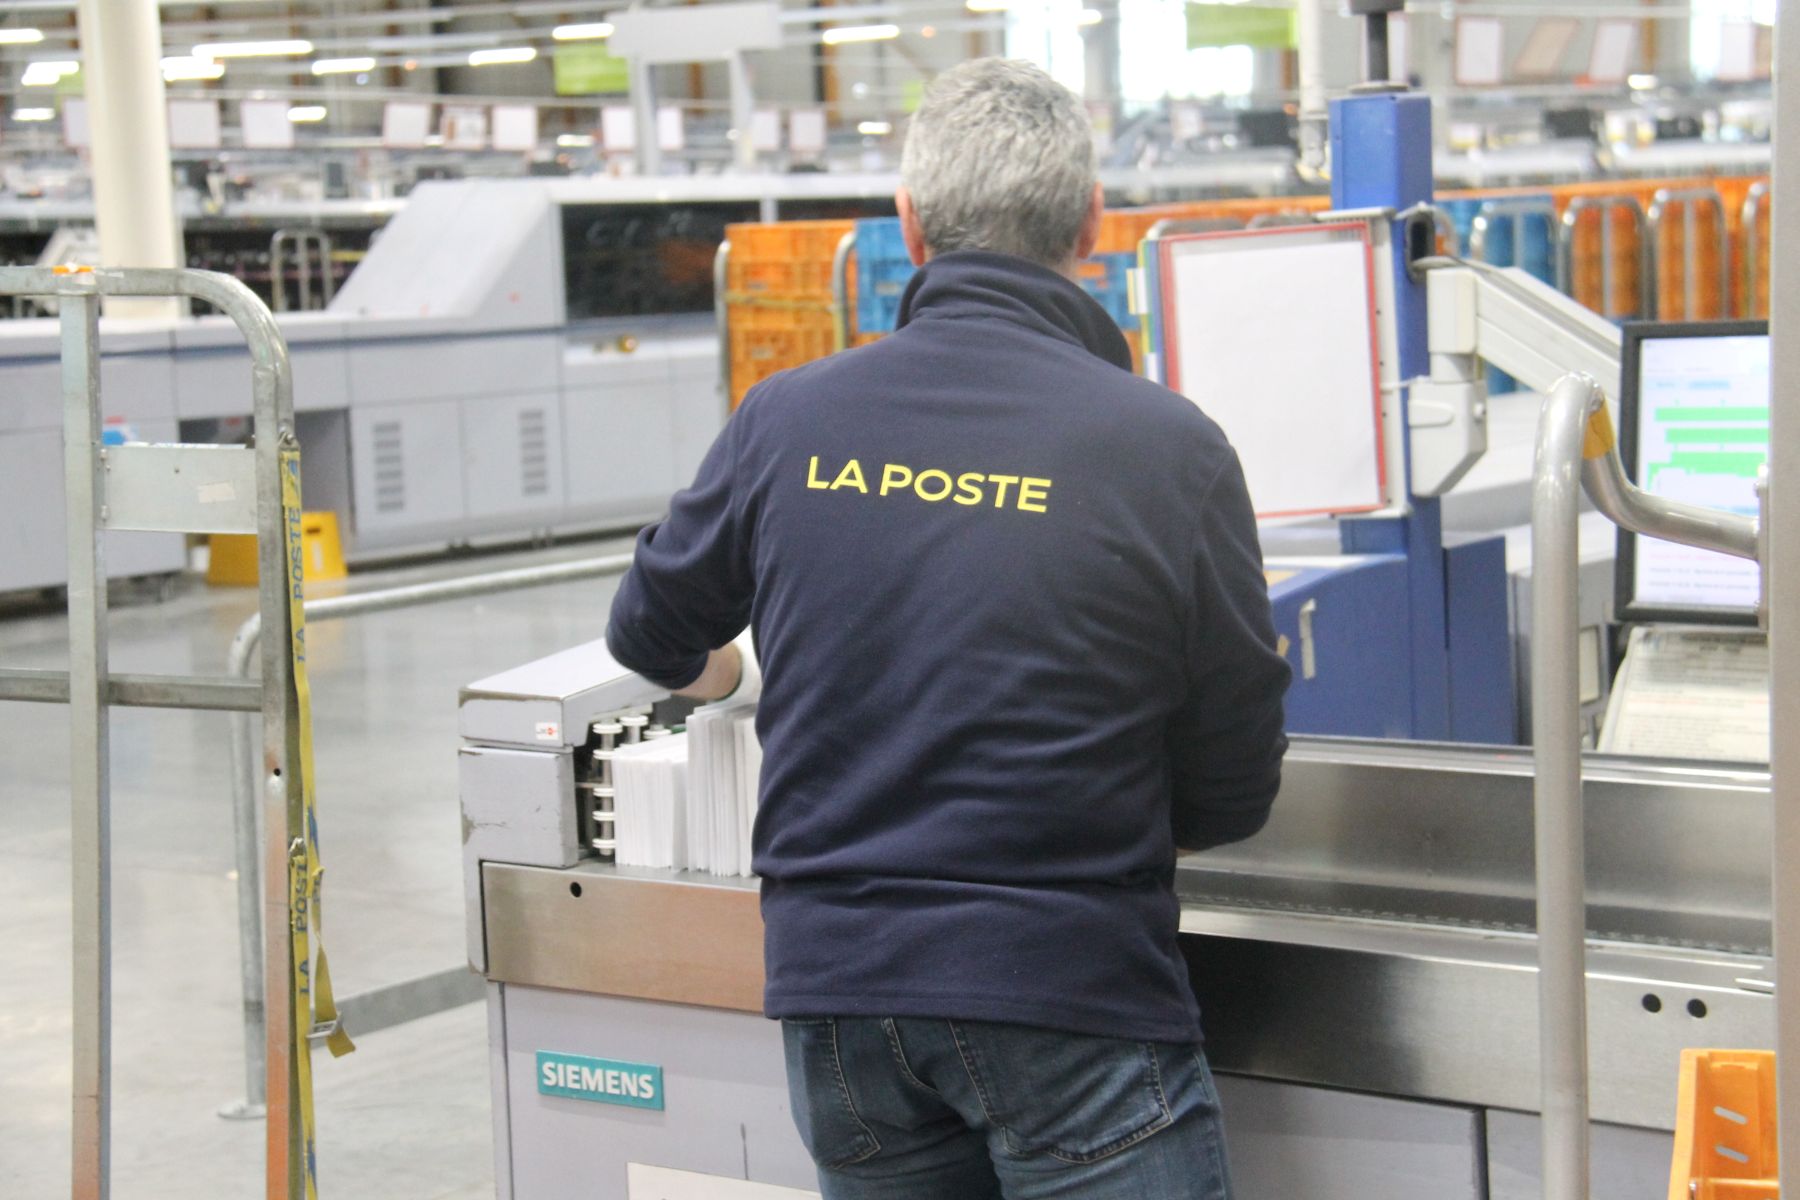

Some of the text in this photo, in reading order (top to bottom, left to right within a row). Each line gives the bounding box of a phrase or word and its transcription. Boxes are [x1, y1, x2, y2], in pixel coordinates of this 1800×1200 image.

[807, 456, 1052, 513] LA POSTE
[289, 508, 303, 599] POSTE
[542, 1062, 654, 1098] SIEMENS
